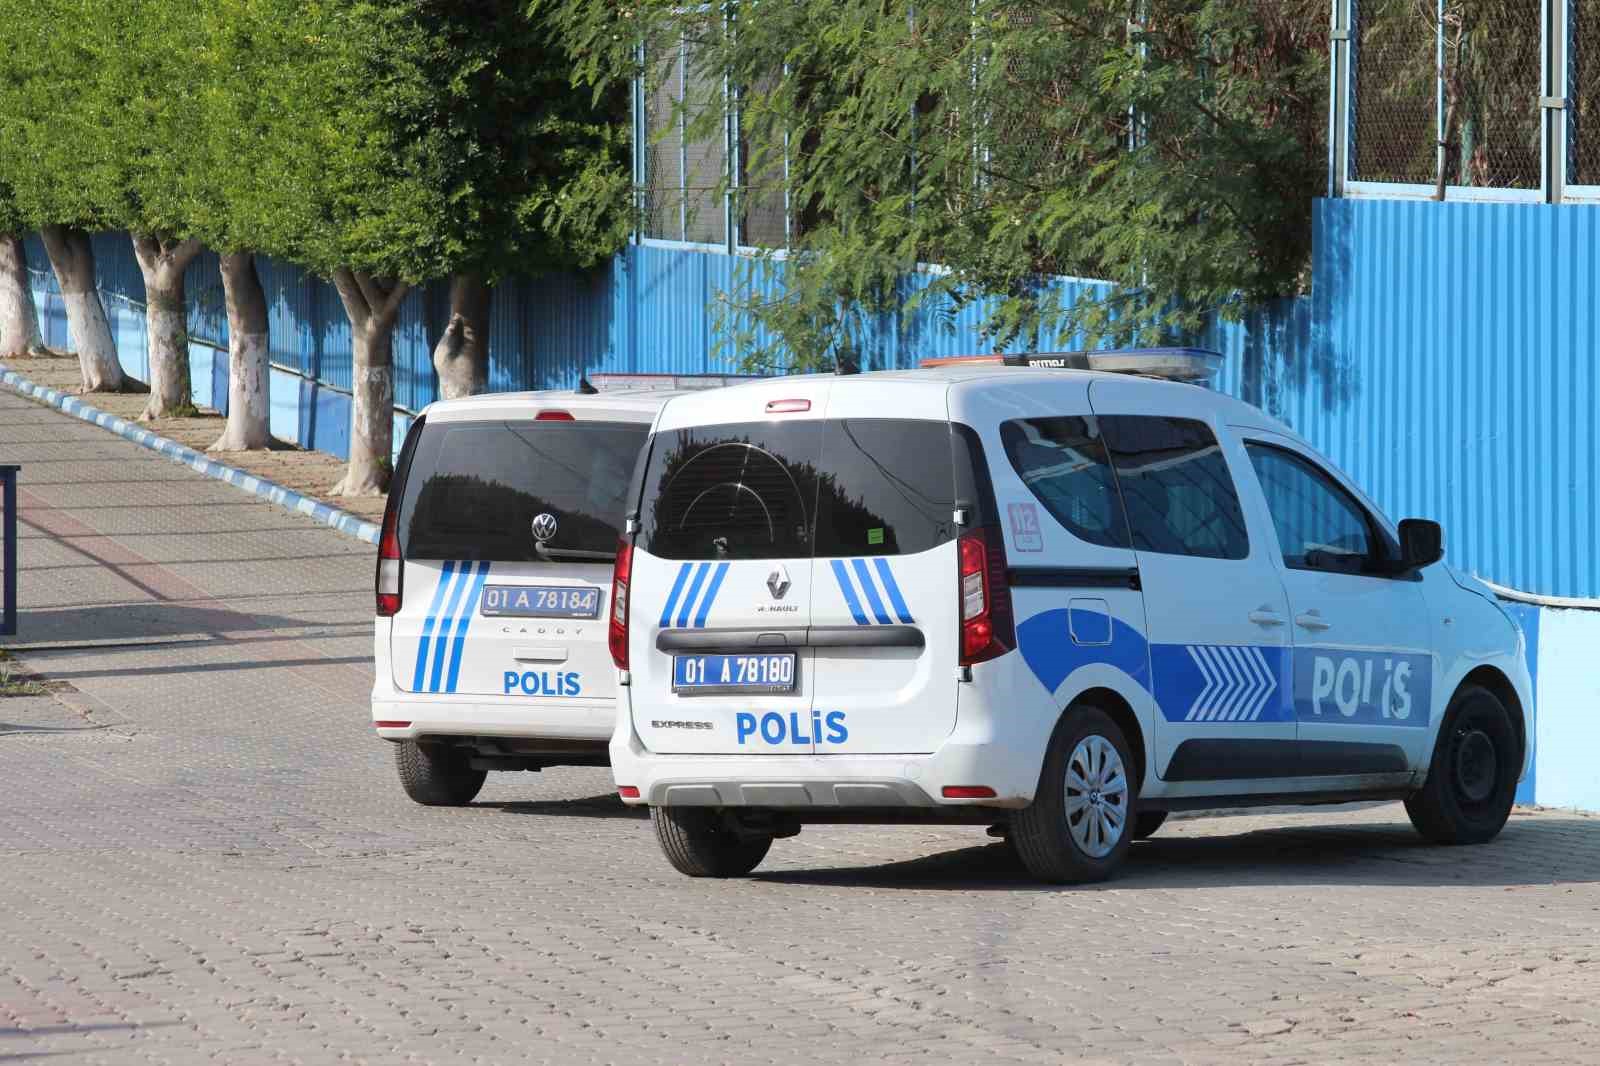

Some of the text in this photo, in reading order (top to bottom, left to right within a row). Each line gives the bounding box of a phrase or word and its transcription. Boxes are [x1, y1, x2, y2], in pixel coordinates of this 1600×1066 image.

[487, 591, 593, 609] 01 A 78184
[686, 657, 791, 682] 01 A 78180
[651, 719, 713, 730] EXPRESS
